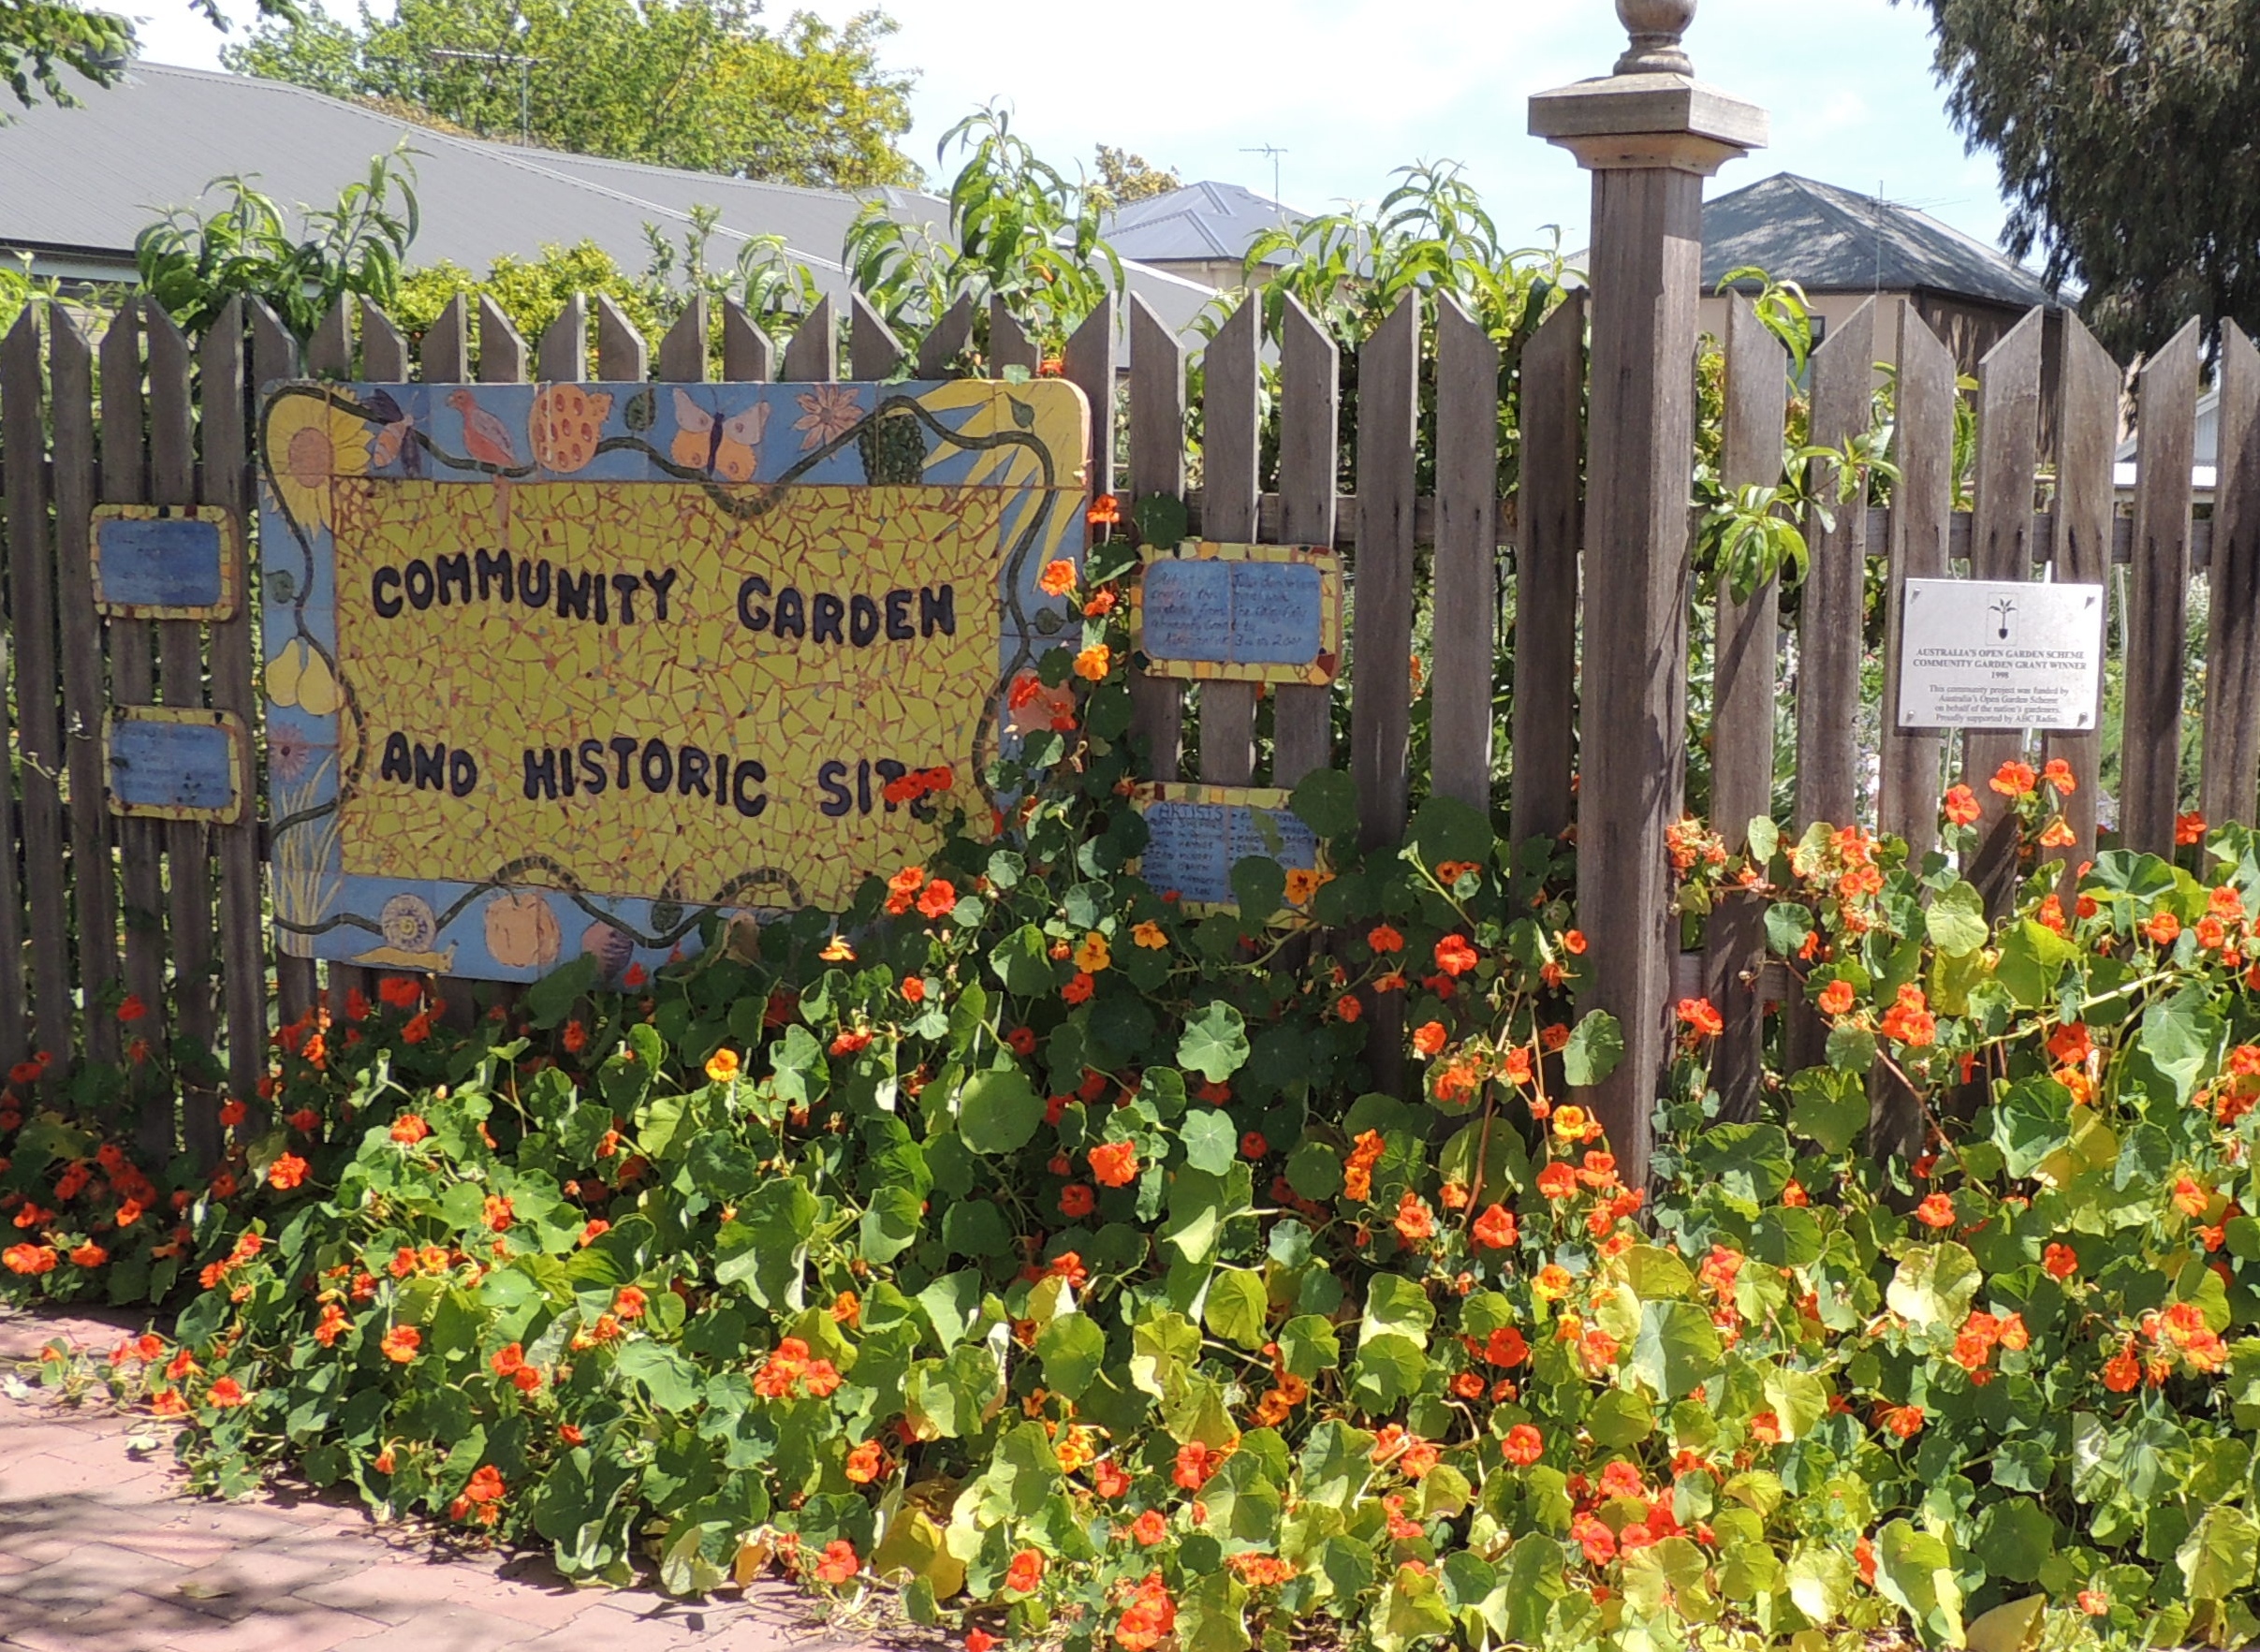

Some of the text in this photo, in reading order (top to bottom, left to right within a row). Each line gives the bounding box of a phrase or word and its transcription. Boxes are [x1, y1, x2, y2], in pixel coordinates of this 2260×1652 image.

[372, 548, 956, 647] COMMUNITY GARDEN
[1916, 649, 2085, 659] AUSTRALIA'S OPEN GARDEN SCHEME
[1913, 659, 2087, 670] COMMUNITY GARDEN GRANT WINNER
[1947, 686, 1989, 694] community
[2060, 687, 2069, 695] by
[1980, 695, 1999, 704] Open
[1936, 714, 1963, 723] Proudly
[1967, 715, 2003, 724] supported
[381, 732, 477, 797] AND
[524, 738, 768, 817] HISTORIC
[1158, 802, 1224, 823] ARTISTS
